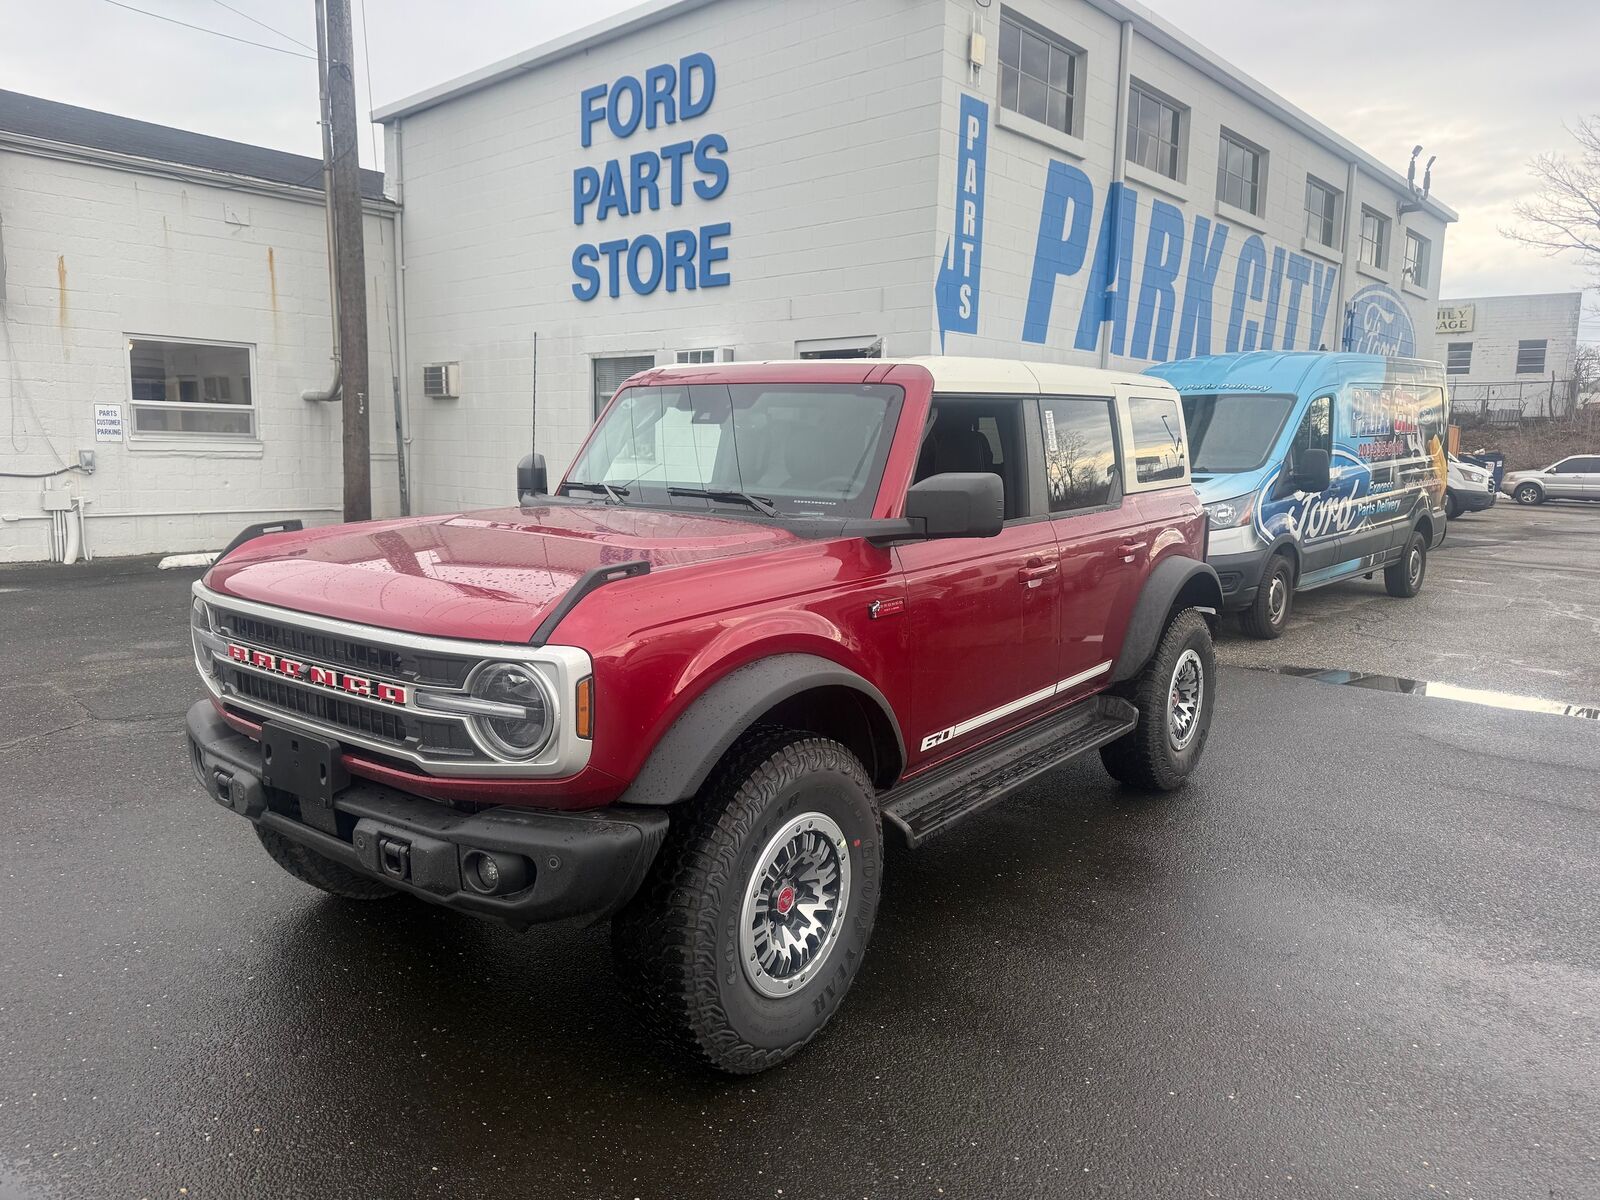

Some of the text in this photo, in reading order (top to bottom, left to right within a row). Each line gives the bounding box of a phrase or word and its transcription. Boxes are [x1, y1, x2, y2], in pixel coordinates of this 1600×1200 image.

[581, 52, 716, 148] FORD
[573, 133, 729, 225] PARTS
[959, 114, 980, 320] PARTS
[571, 222, 731, 302] STORE
[1021, 158, 1337, 363] PARK CITY
[98, 409, 118, 417] PARTS
[1218, 382, 1272, 392] Delivery
[96, 418, 121, 426] CUSTOMER
[96, 428, 122, 436] PARKING
[1288, 479, 1360, 541] Ford
[1357, 498, 1402, 517] Parts Delivery
[1369, 480, 1395, 496] Express
[228, 643, 407, 704] BRONCO
